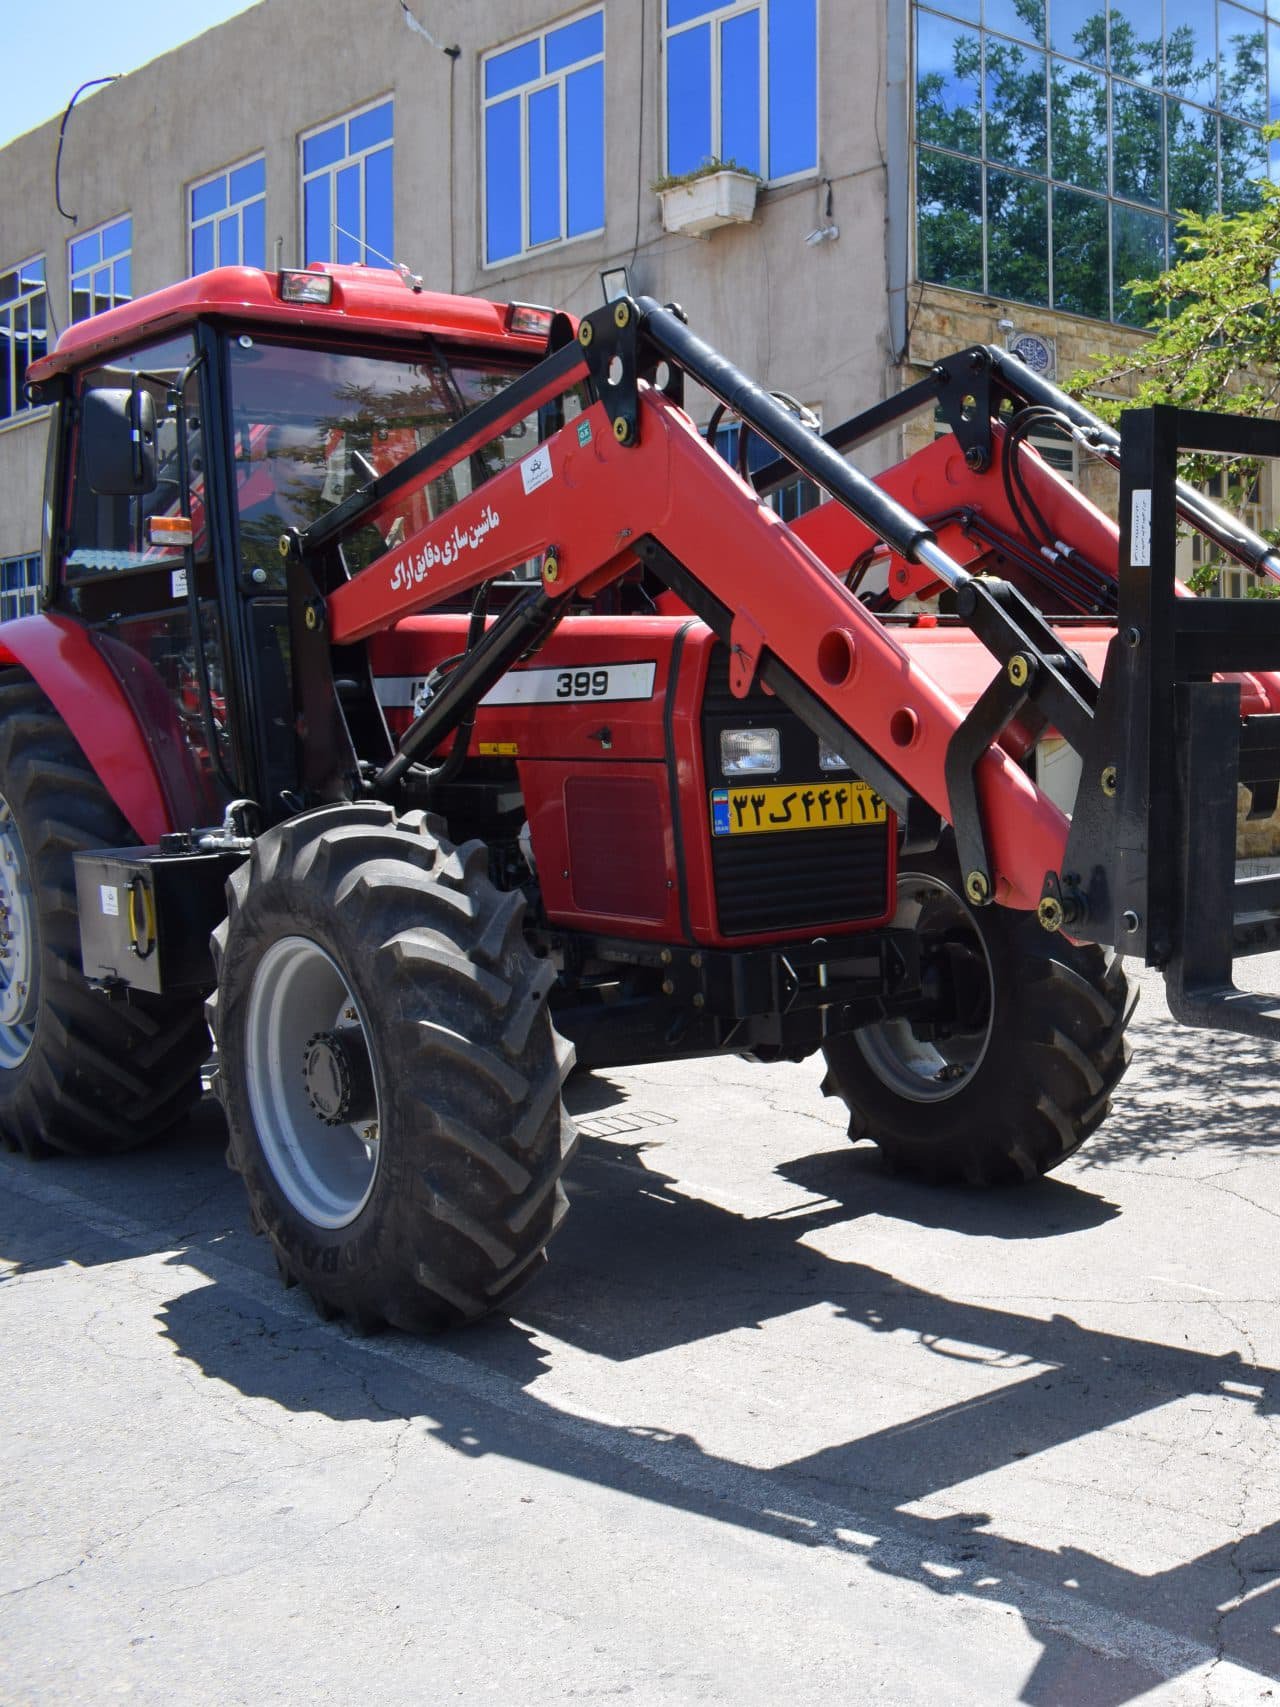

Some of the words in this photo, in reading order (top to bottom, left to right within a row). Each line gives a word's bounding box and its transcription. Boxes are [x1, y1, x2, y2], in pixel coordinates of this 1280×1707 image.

[441, 525, 469, 567] سازی
[469, 505, 500, 549] ماشین
[390, 555, 414, 591] اراک
[414, 541, 440, 583] دقایق
[556, 671, 609, 698] 399
